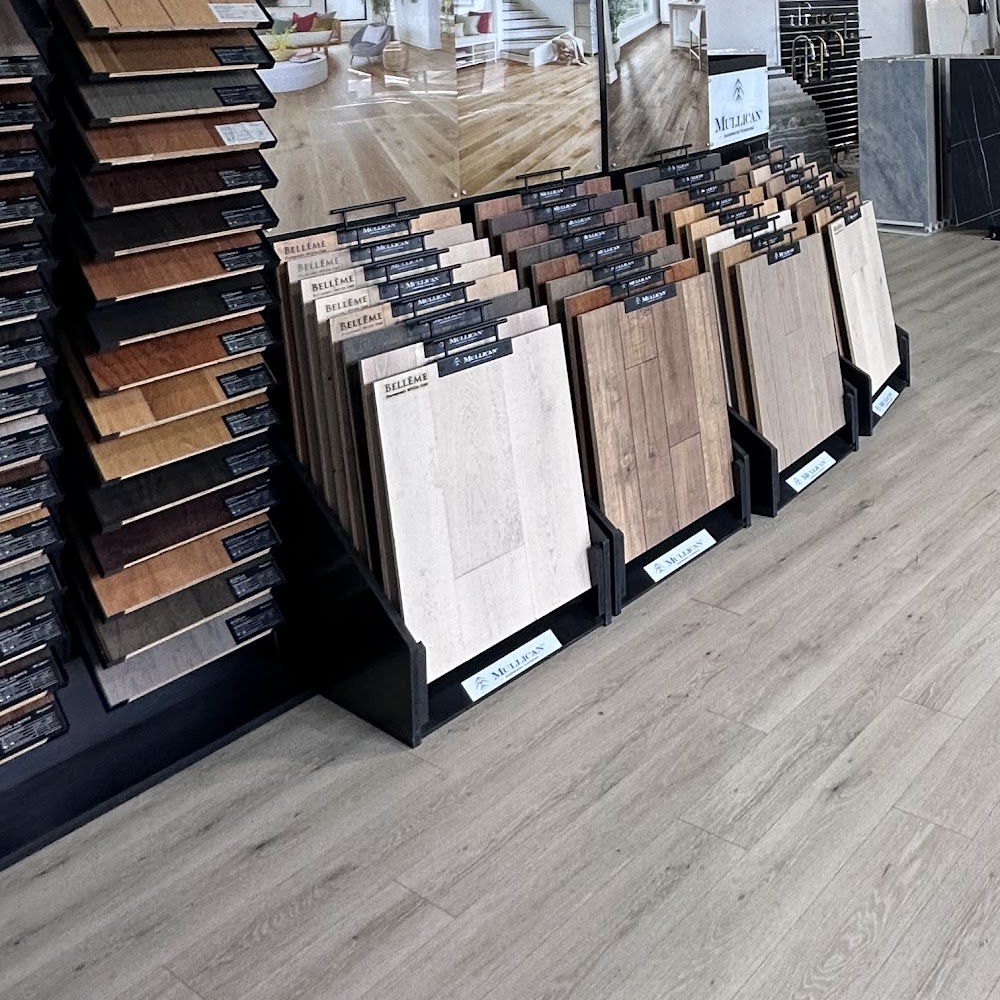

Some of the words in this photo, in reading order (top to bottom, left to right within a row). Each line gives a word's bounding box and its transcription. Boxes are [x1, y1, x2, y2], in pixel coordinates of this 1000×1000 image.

[715, 111, 761, 133] MULLICAN
[464, 348, 499, 363] MULLICAN
[385, 373, 428, 393] BELLÊME
[491, 645, 545, 681] MULLICAN
